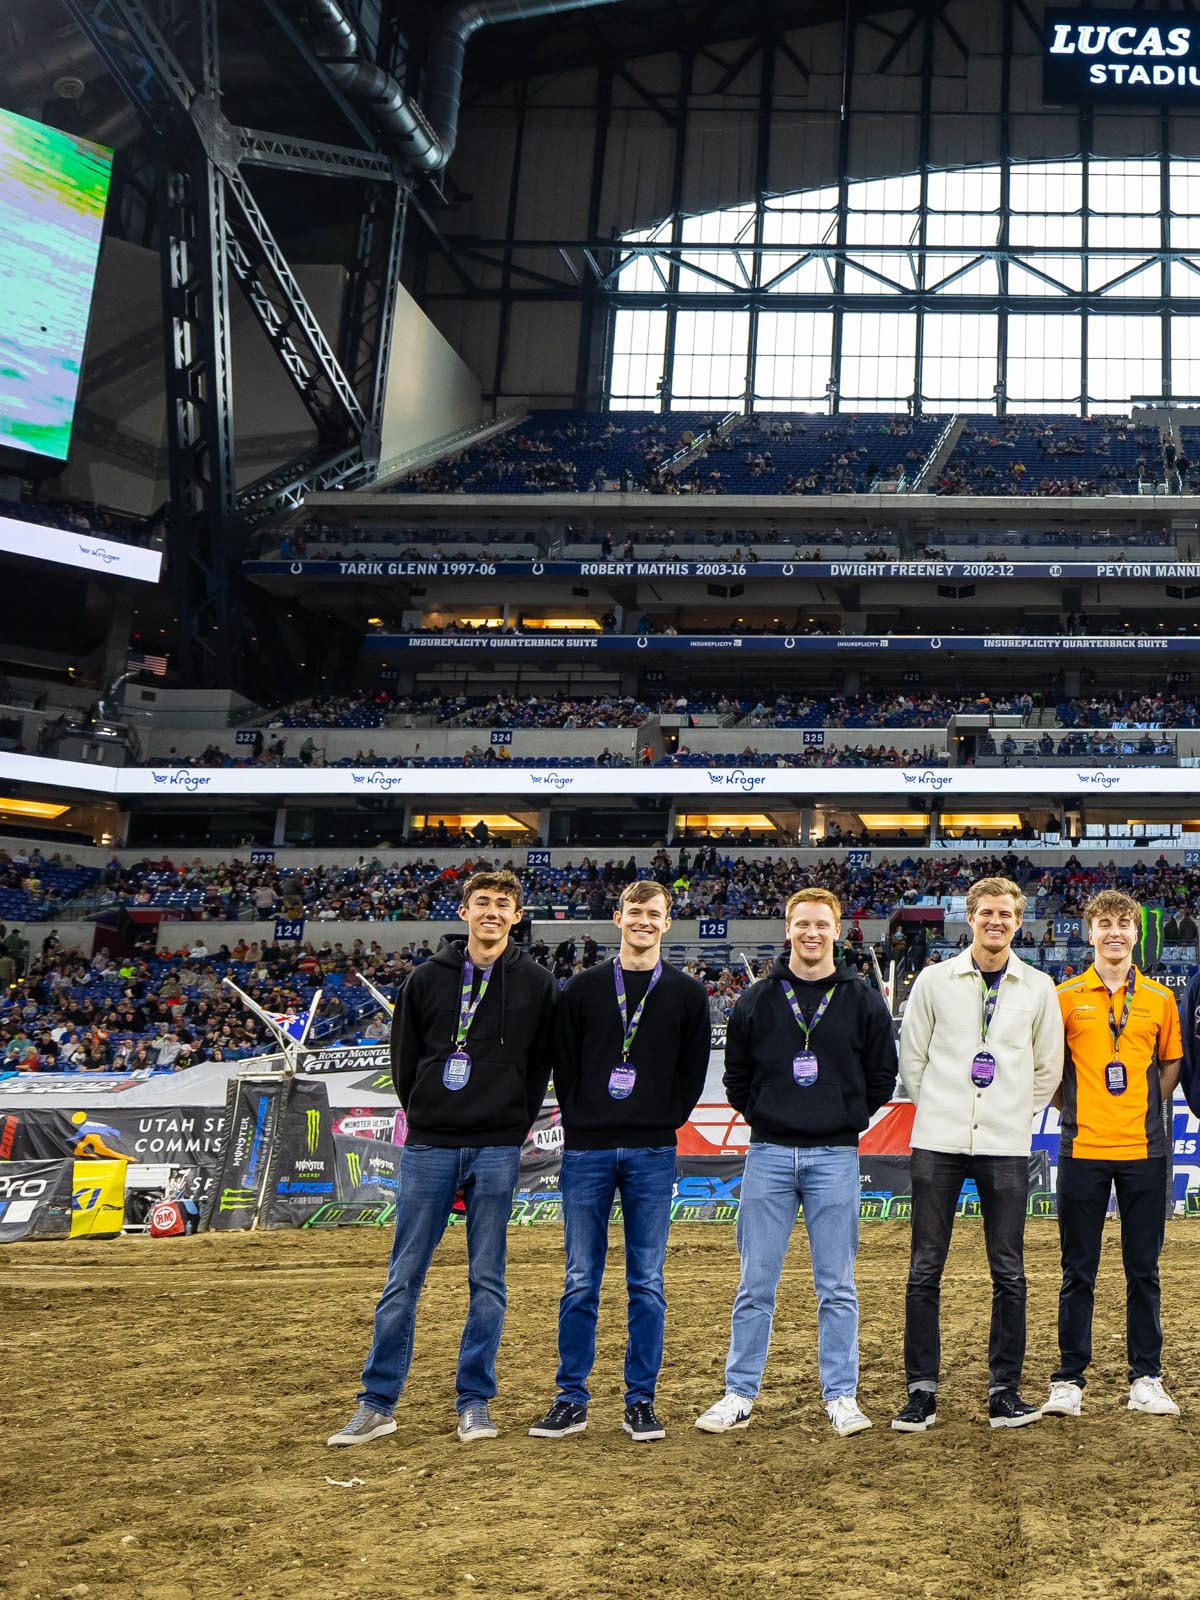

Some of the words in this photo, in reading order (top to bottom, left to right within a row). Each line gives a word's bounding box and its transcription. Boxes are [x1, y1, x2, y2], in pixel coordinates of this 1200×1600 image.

[1050, 25, 1191, 56] LUCAS
[339, 563, 382, 575] TARIK
[388, 563, 437, 575] GLENN
[442, 563, 496, 575] 1997-06
[581, 564, 631, 576] ROBERT
[637, 564, 689, 576] MATHIS
[696, 564, 747, 577] 2003-16
[830, 564, 886, 577] DWIGHT
[890, 564, 954, 577] FREENEY
[963, 565, 1014, 577] 2002-12
[1097, 565, 1150, 577] PEYTON
[408, 638, 488, 648] INSUREPLICITY
[490, 639, 564, 648] QUARTERBACK
[566, 639, 598, 648] SUITE
[983, 639, 1061, 648] INSUREPLICITY
[1062, 640, 1136, 649] QUARTERBACK
[1137, 640, 1168, 648] SUITE
[237, 733, 256, 742] 323
[492, 733, 511, 742] 324
[804, 734, 823, 743] 325
[170, 769, 211, 791] Kroger
[367, 771, 402, 790] Kroger
[543, 773, 574, 788] Kroger
[726, 769, 766, 791] Kroger
[918, 770, 953, 789] Kroger
[1091, 772, 1120, 788] Kroger
[529, 854, 549, 863] 224
[277, 925, 301, 937] 124
[701, 923, 724, 934] 125
[318, 1050, 347, 1060] ROCKY
[138, 1118, 195, 1133] UTAH
[344, 1119, 371, 1128] MONSTER
[372, 1119, 391, 1127] ULTRA
[232, 1116, 251, 1167] MONSTER
[294, 1159, 325, 1172] MONSTER
